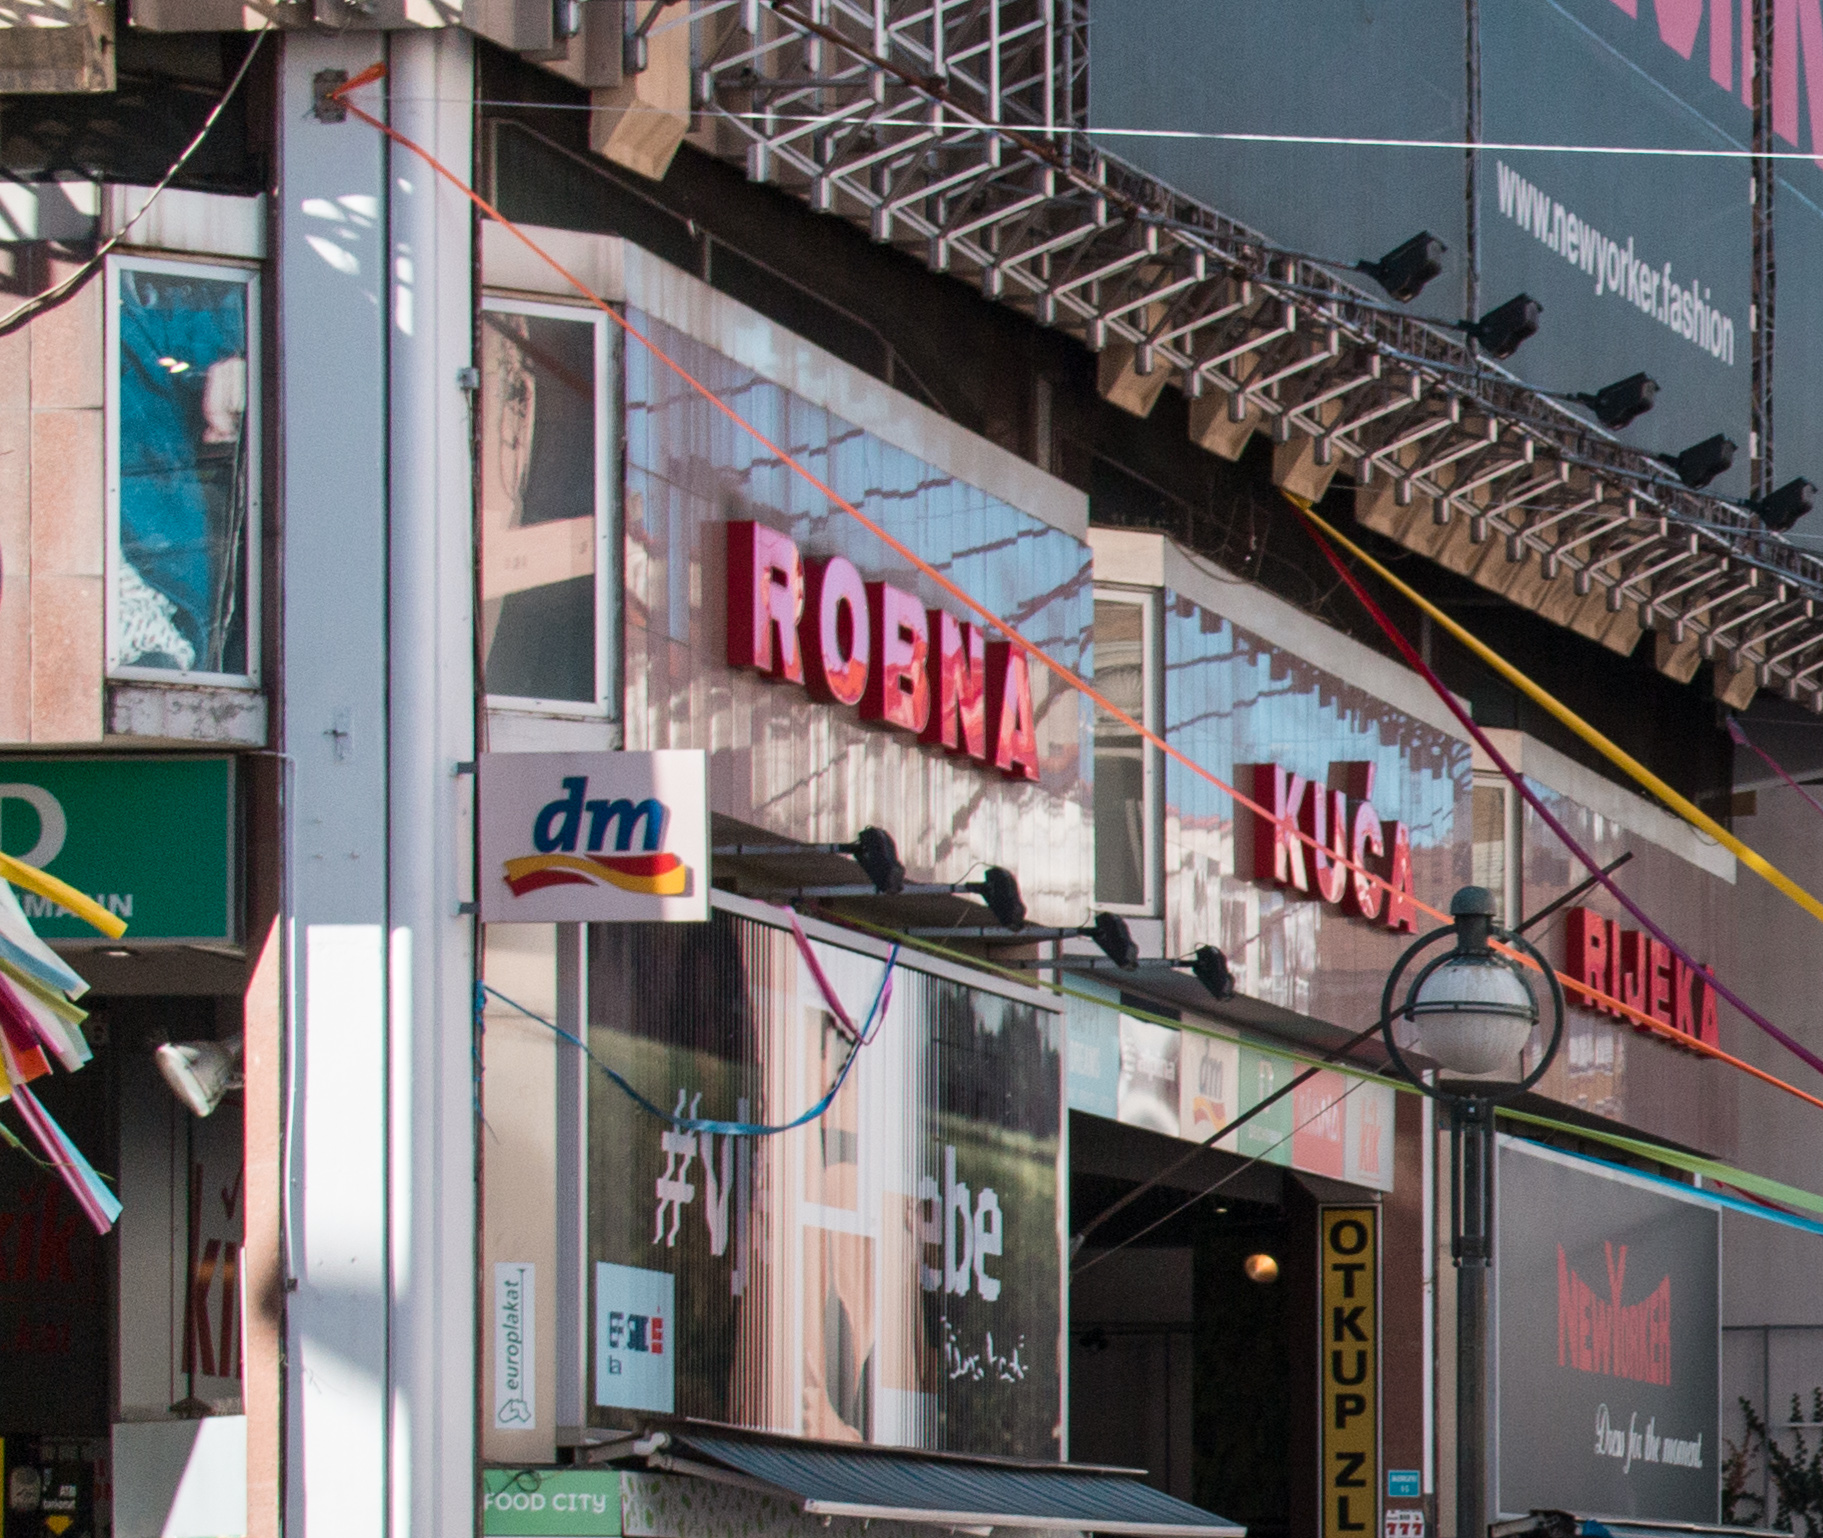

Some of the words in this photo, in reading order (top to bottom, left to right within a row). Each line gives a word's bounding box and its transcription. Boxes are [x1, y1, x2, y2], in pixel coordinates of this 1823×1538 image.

[1497, 160, 1734, 366] www.newyorker.fashion
[532, 777, 673, 855] dm
[728, 520, 1041, 782] ROBNA
[1252, 758, 1418, 934] KUĆA
[1566, 905, 1720, 1056] RIJEKA
[505, 1278, 522, 1391] europlakat
[1329, 1219, 1369, 1429] OTKUP
[484, 1493, 546, 1511] FOOD
[552, 1493, 606, 1514] CITY
